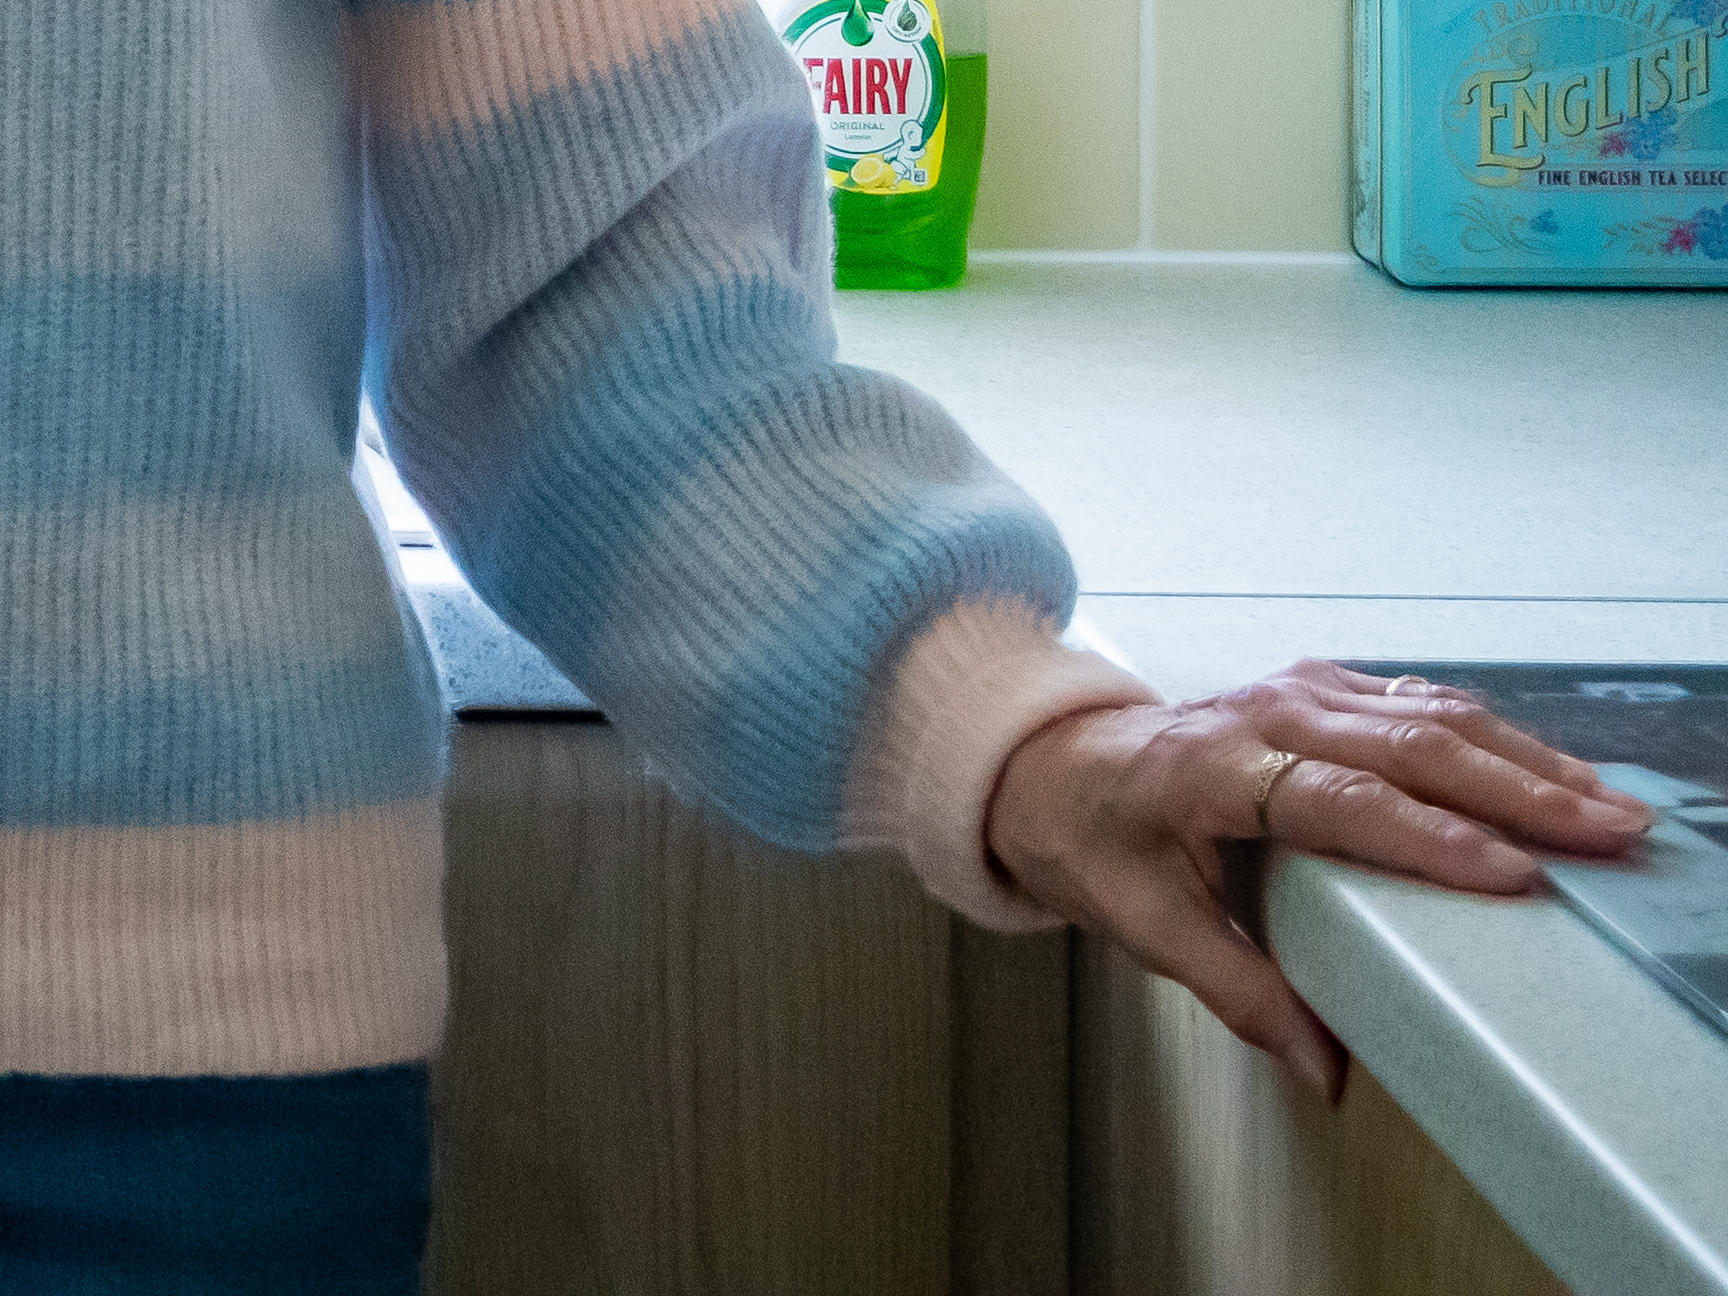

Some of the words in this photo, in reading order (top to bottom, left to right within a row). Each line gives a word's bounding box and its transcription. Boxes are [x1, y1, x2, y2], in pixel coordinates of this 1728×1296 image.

[1459, 25, 1710, 171] ENGLISH
[829, 121, 885, 131] ORIGINAL
[1538, 169, 1571, 186] FINE
[1578, 169, 1642, 186] ENGLISH
[1648, 169, 1678, 186] TEA
